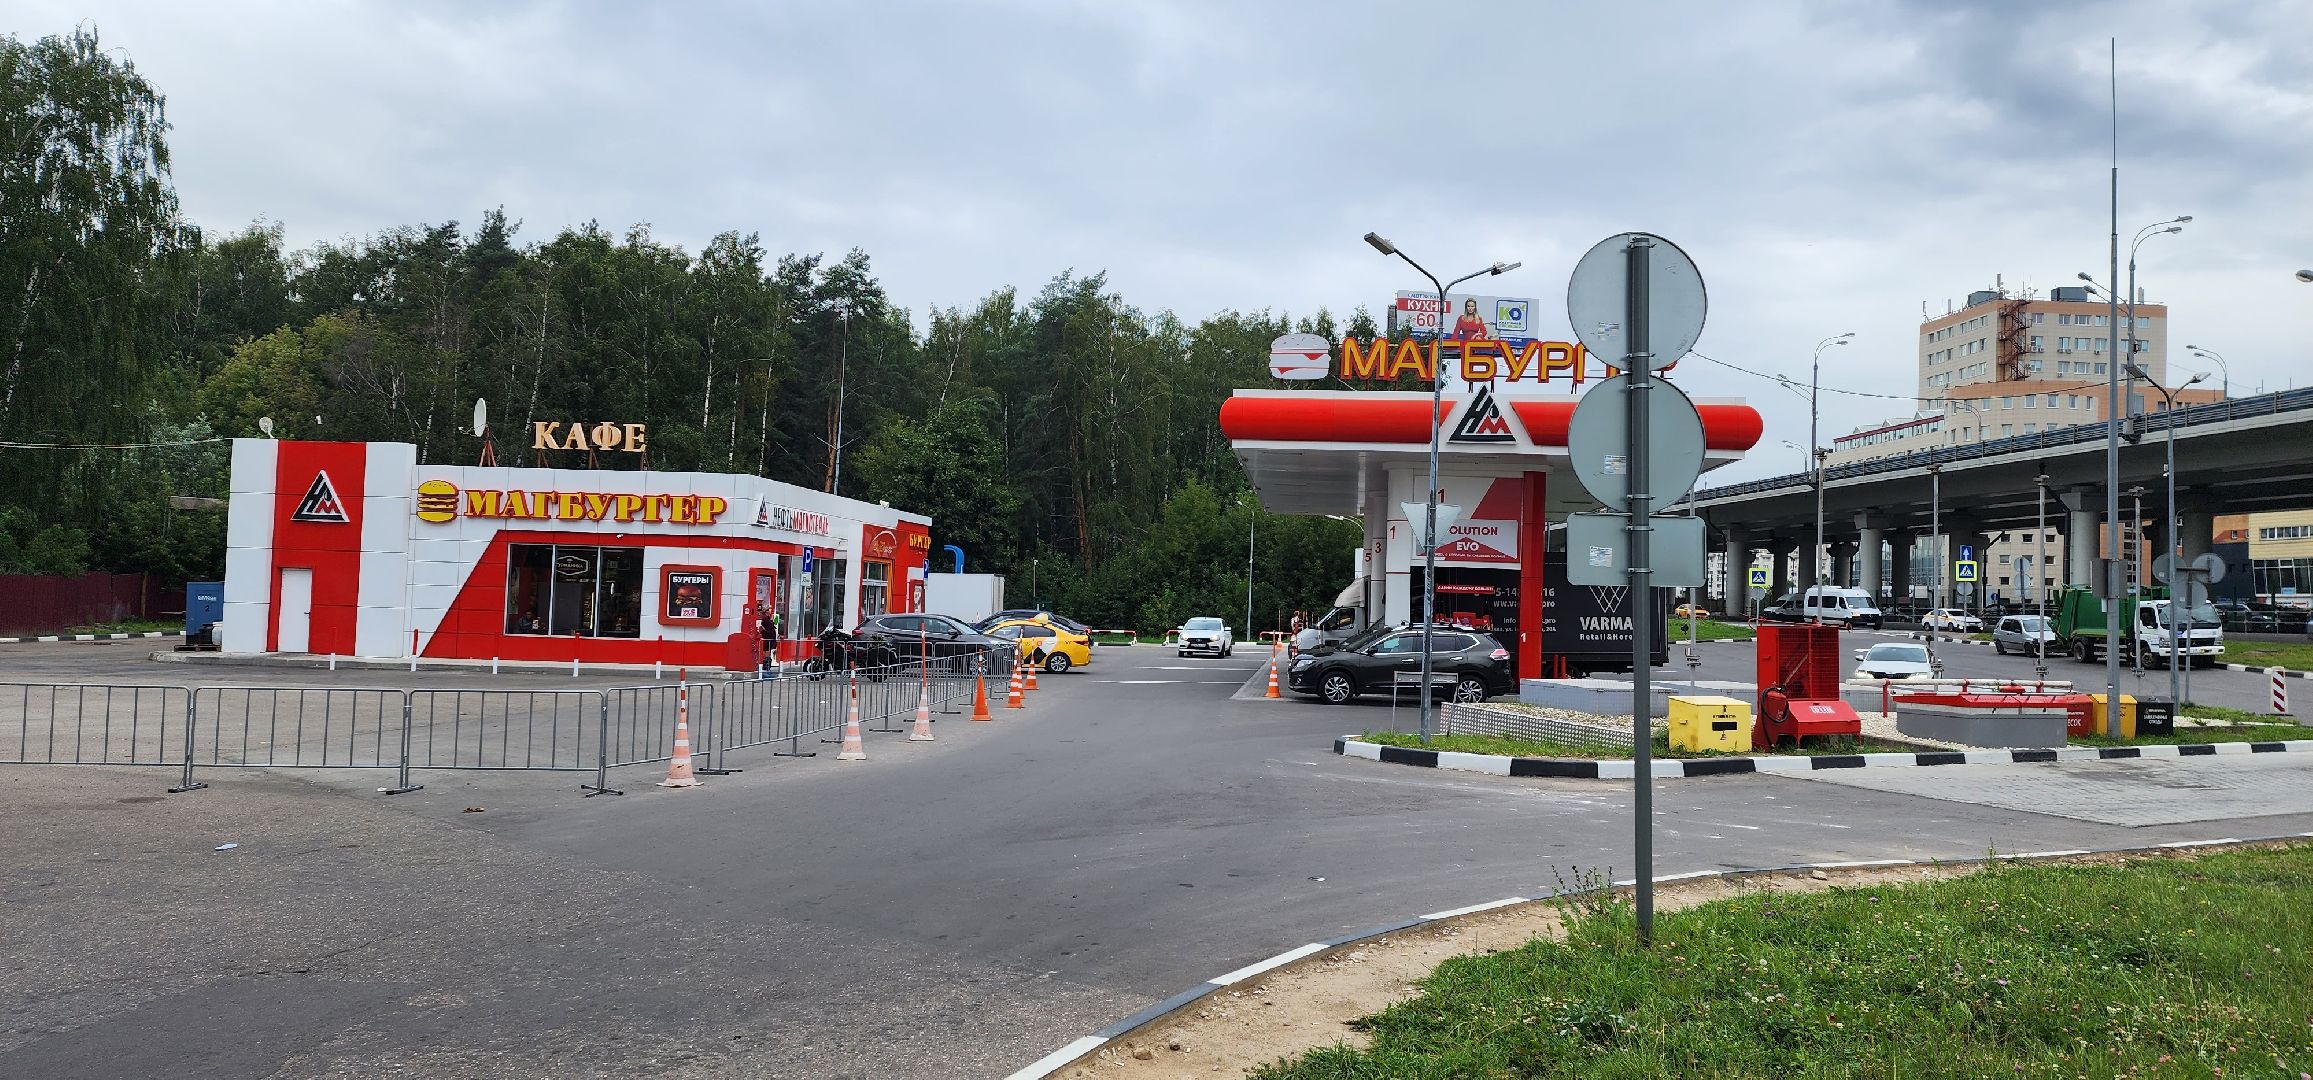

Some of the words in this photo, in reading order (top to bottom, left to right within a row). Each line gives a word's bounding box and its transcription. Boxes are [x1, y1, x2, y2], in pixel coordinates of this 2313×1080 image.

[532, 421, 647, 453] КАФЕ
[1437, 488, 1445, 503] 1
[464, 489, 727, 525] МАГБУРГЕР
[1389, 525, 1396, 540] 1
[909, 533, 932, 549] БУРГЕР
[1456, 541, 1480, 552] EVO
[1375, 542, 1382, 554] 3
[1364, 552, 1372, 563] 5
[672, 576, 709, 584] БУРГЕРЫ
[1579, 616, 1634, 631] VARMA
[1520, 633, 1527, 643] 1
[2067, 718, 2082, 727] ЕСОК
